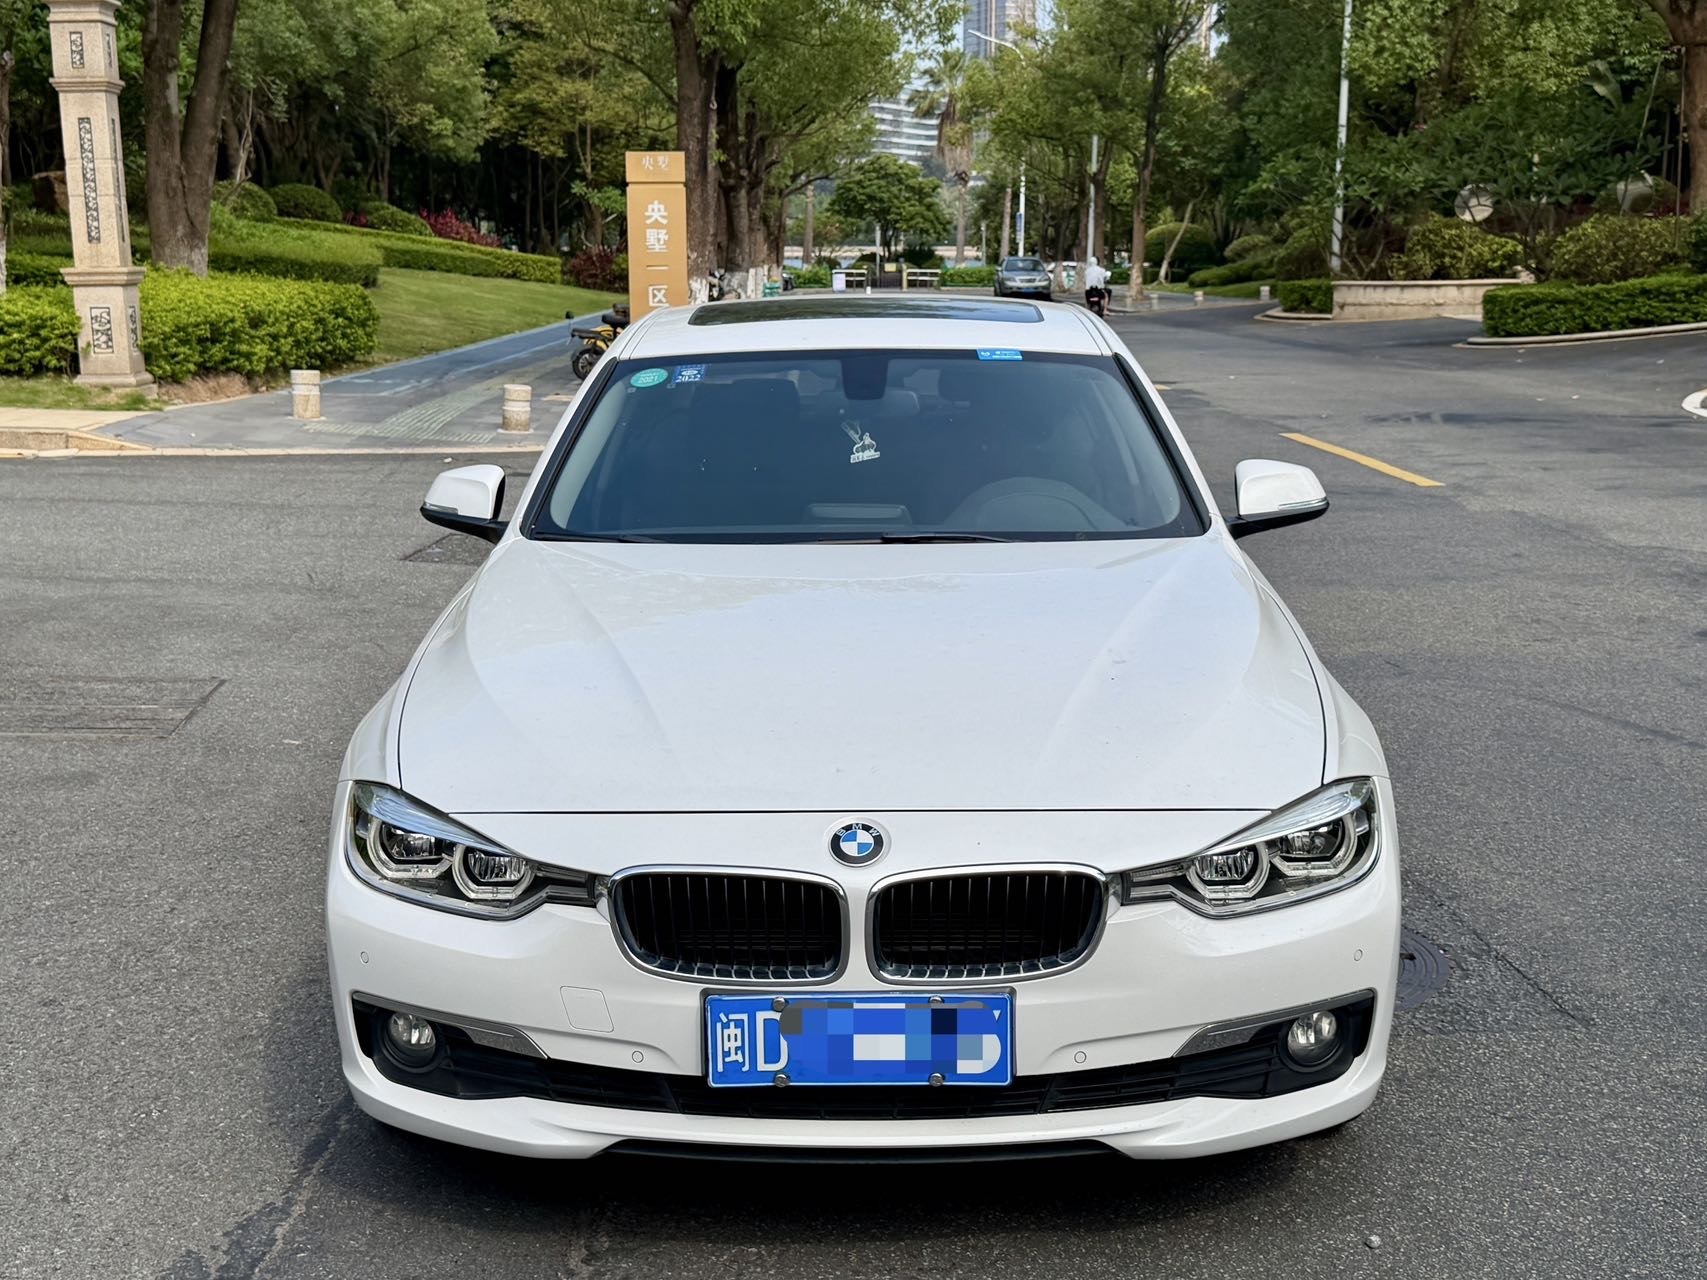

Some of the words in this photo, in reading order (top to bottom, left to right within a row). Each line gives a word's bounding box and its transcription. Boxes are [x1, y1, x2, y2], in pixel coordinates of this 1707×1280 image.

[644, 200, 670, 307] 央墅一区
[638, 375, 659, 384] 2021
[675, 374, 701, 383] 2022
[836, 823, 880, 837] BMW
